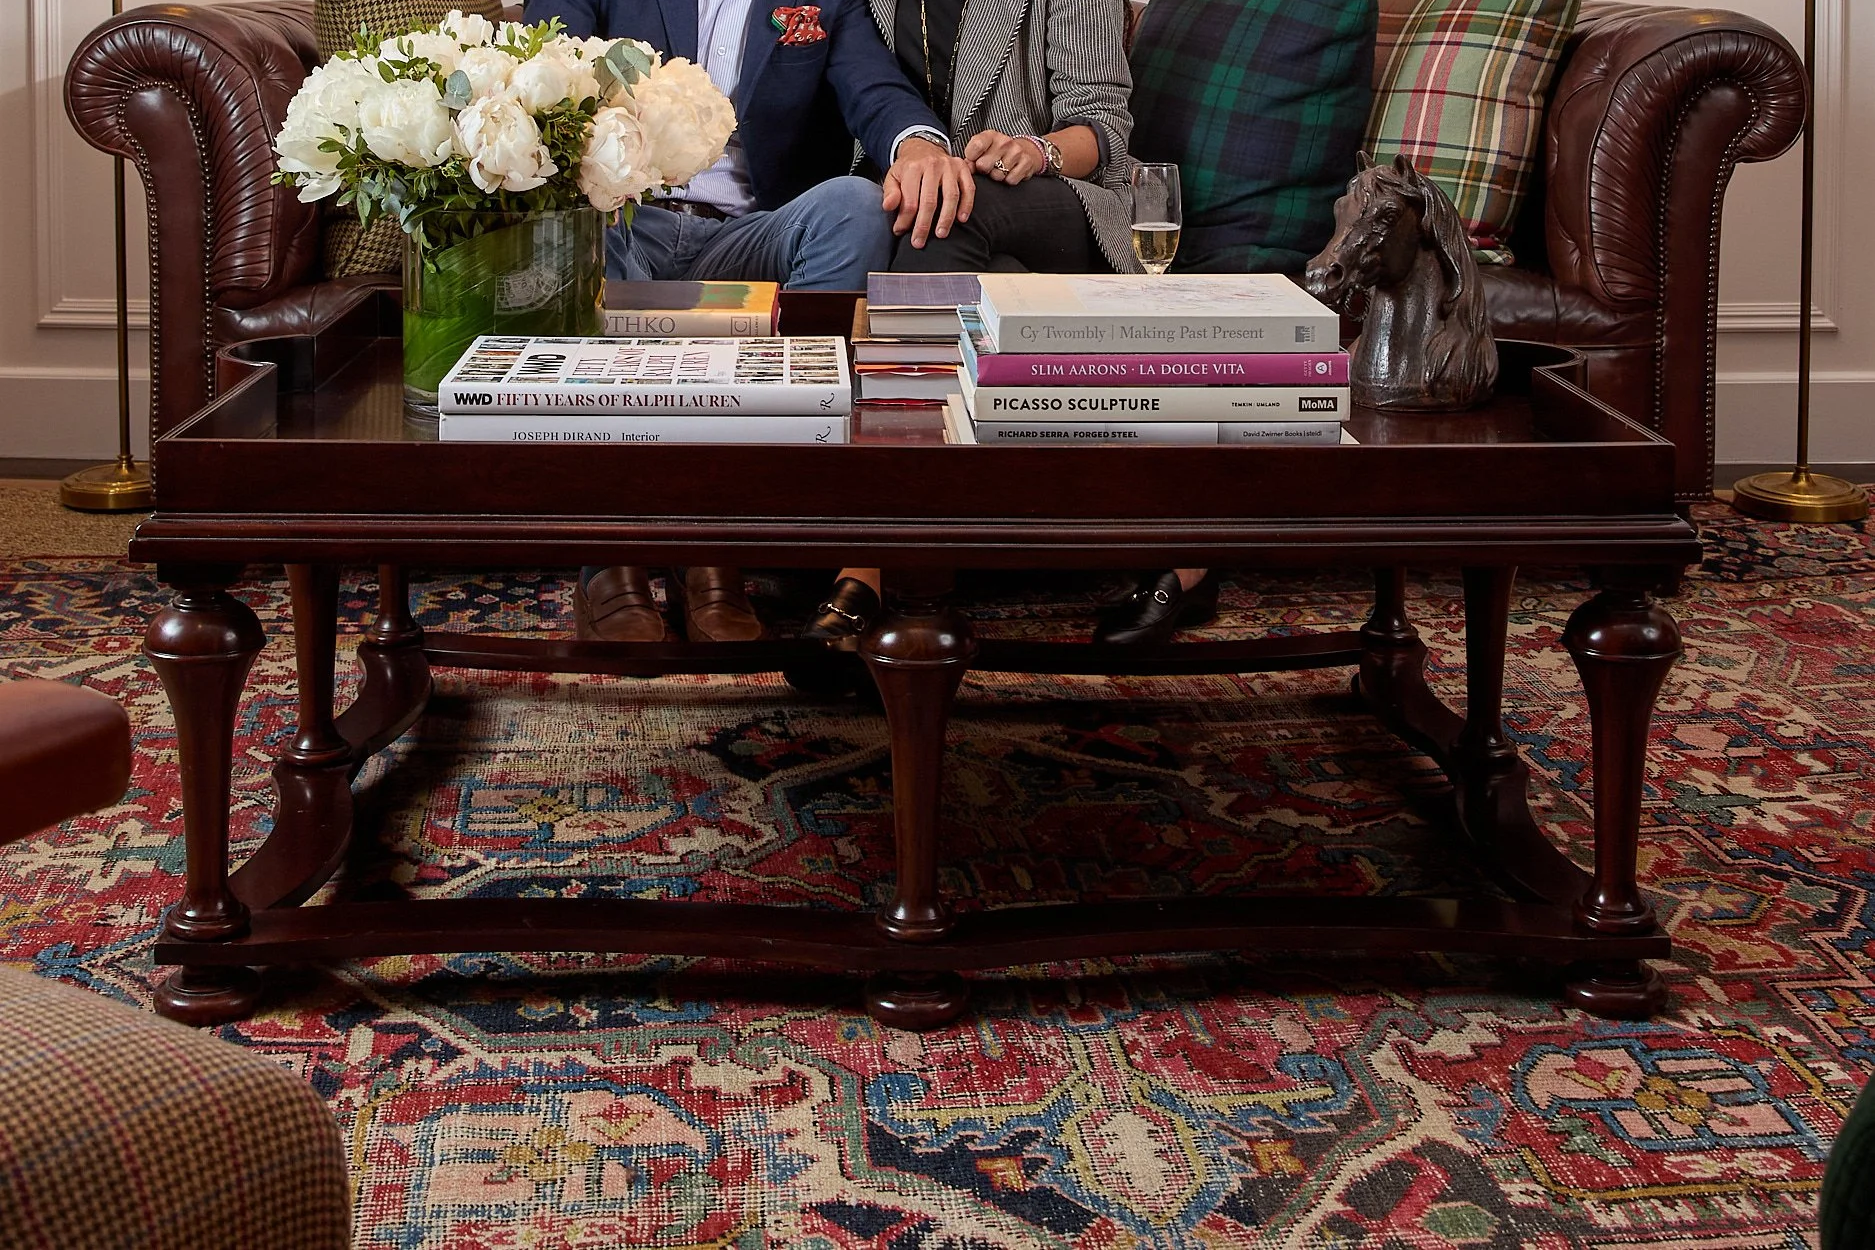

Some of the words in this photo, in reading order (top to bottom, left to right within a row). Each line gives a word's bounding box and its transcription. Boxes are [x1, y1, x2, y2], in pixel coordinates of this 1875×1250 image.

[605, 316, 676, 334] THKO
[1020, 325, 1040, 343] Cy
[1043, 325, 1107, 343] Twombly
[1119, 325, 1176, 343] Making
[1180, 326, 1208, 339] Past
[1212, 326, 1265, 339] Present
[517, 353, 567, 375] WWD
[1031, 364, 1064, 376] SLIM
[1069, 364, 1127, 375] AARONS
[1139, 364, 1156, 375] LA
[1160, 363, 1208, 375] DOLCE
[1213, 363, 1245, 375] VITA
[453, 392, 493, 406] WWD
[497, 393, 541, 406] FIFTY
[544, 393, 595, 407] YEARS
[598, 394, 619, 407] OF
[622, 394, 675, 407] RALPH
[679, 394, 741, 408] LAUREN
[993, 398, 1062, 411] PICASSO
[1068, 398, 1160, 411] SCULPTURE
[1301, 399, 1335, 409] MoMA
[512, 431, 559, 441] JOSEPH
[563, 431, 611, 441] DIRAND
[621, 431, 660, 442] Interior
[998, 430, 1038, 438] RICHARD
